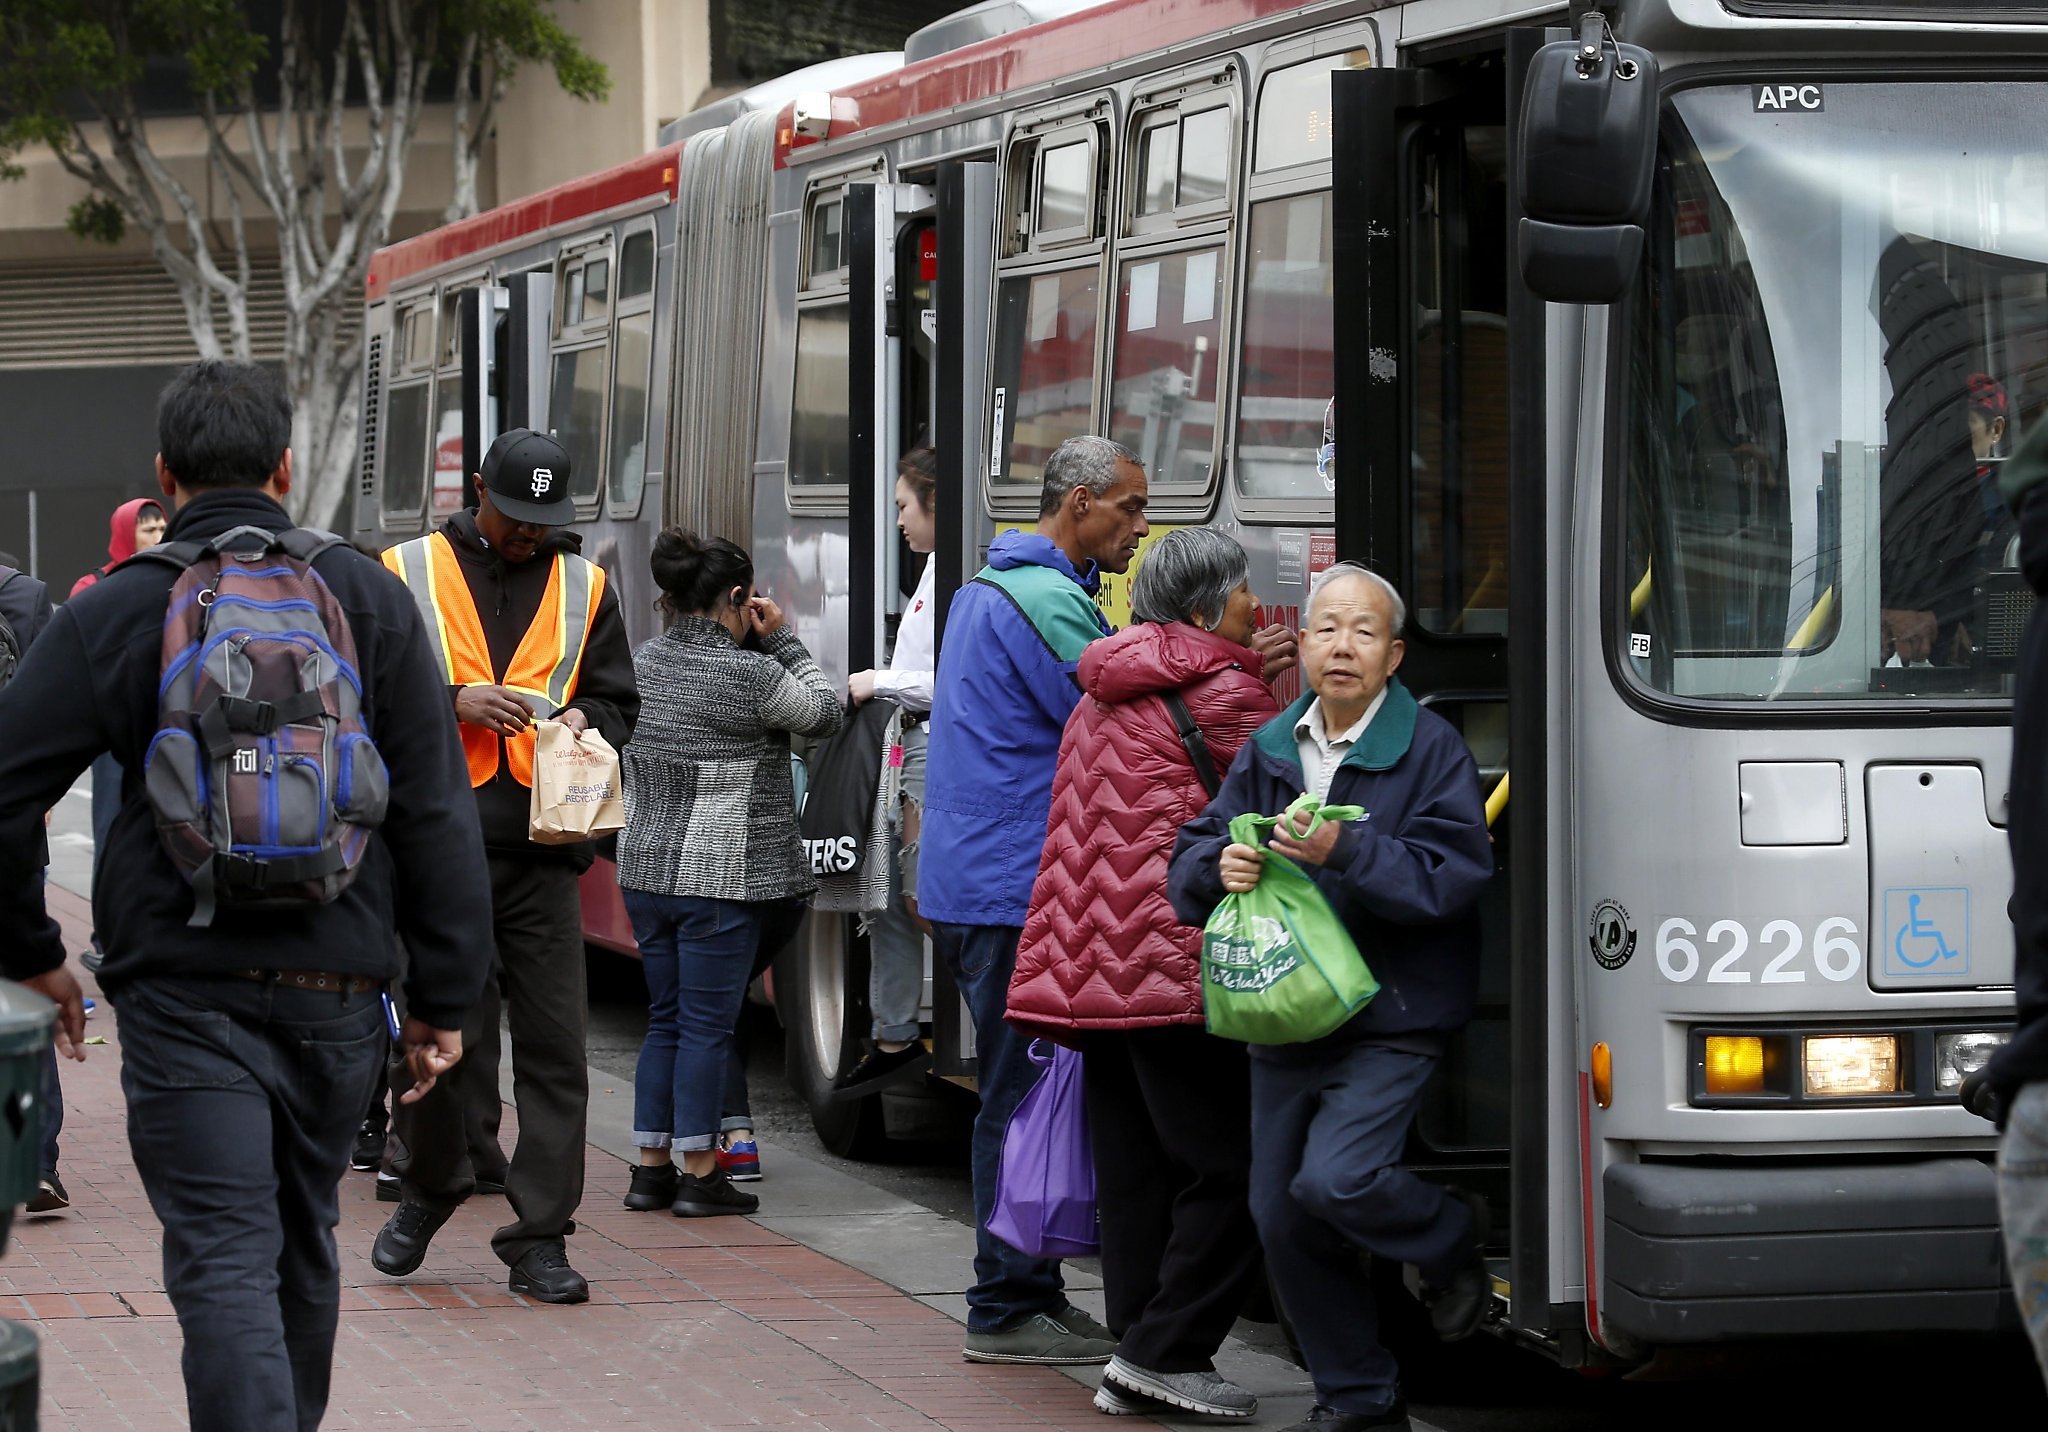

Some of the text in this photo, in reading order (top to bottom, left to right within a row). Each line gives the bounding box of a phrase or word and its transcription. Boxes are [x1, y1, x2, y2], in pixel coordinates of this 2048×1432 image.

[1757, 85, 1820, 109] APC
[531, 467, 553, 498] SF
[1631, 637, 1649, 652] FB
[565, 789, 615, 804] RECYCLABLE
[568, 780, 611, 795] REUSABLE
[801, 836, 857, 874] TERS
[1625, 941, 1635, 956] TAX
[1655, 917, 1862, 984] 6226
